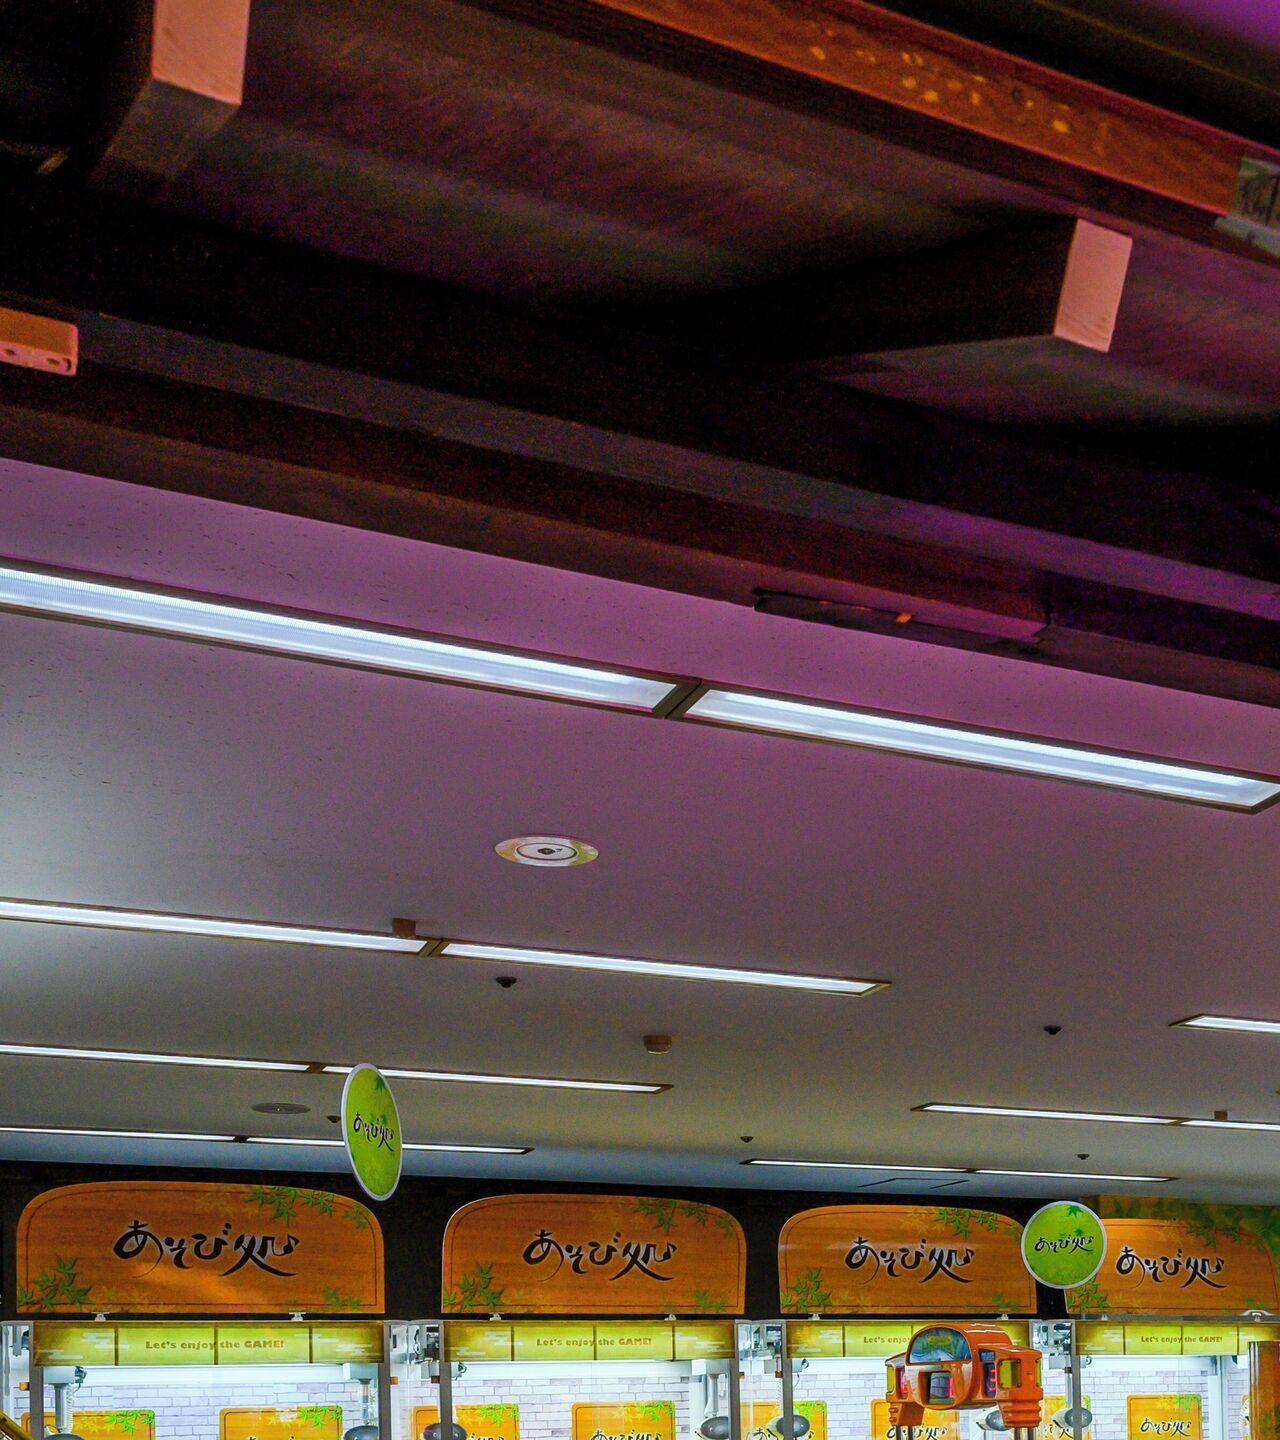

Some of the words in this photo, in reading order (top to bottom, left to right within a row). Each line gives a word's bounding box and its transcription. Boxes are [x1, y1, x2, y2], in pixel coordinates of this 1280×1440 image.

[112, 1218, 301, 1280] あそび処
[522, 1227, 677, 1283] あそび処
[844, 1236, 975, 1286] あそび処
[1034, 1232, 1095, 1256] あそび処
[1114, 1245, 1228, 1290] あそび処
[145, 1340, 178, 1350] Let's
[180, 1340, 215, 1352] enjoy
[219, 1340, 241, 1350] the
[243, 1338, 285, 1349] GAME!
[536, 1337, 563, 1347] Let's
[565, 1337, 595, 1349] enjoy
[598, 1337, 616, 1346] the
[618, 1337, 652, 1347] GAME!
